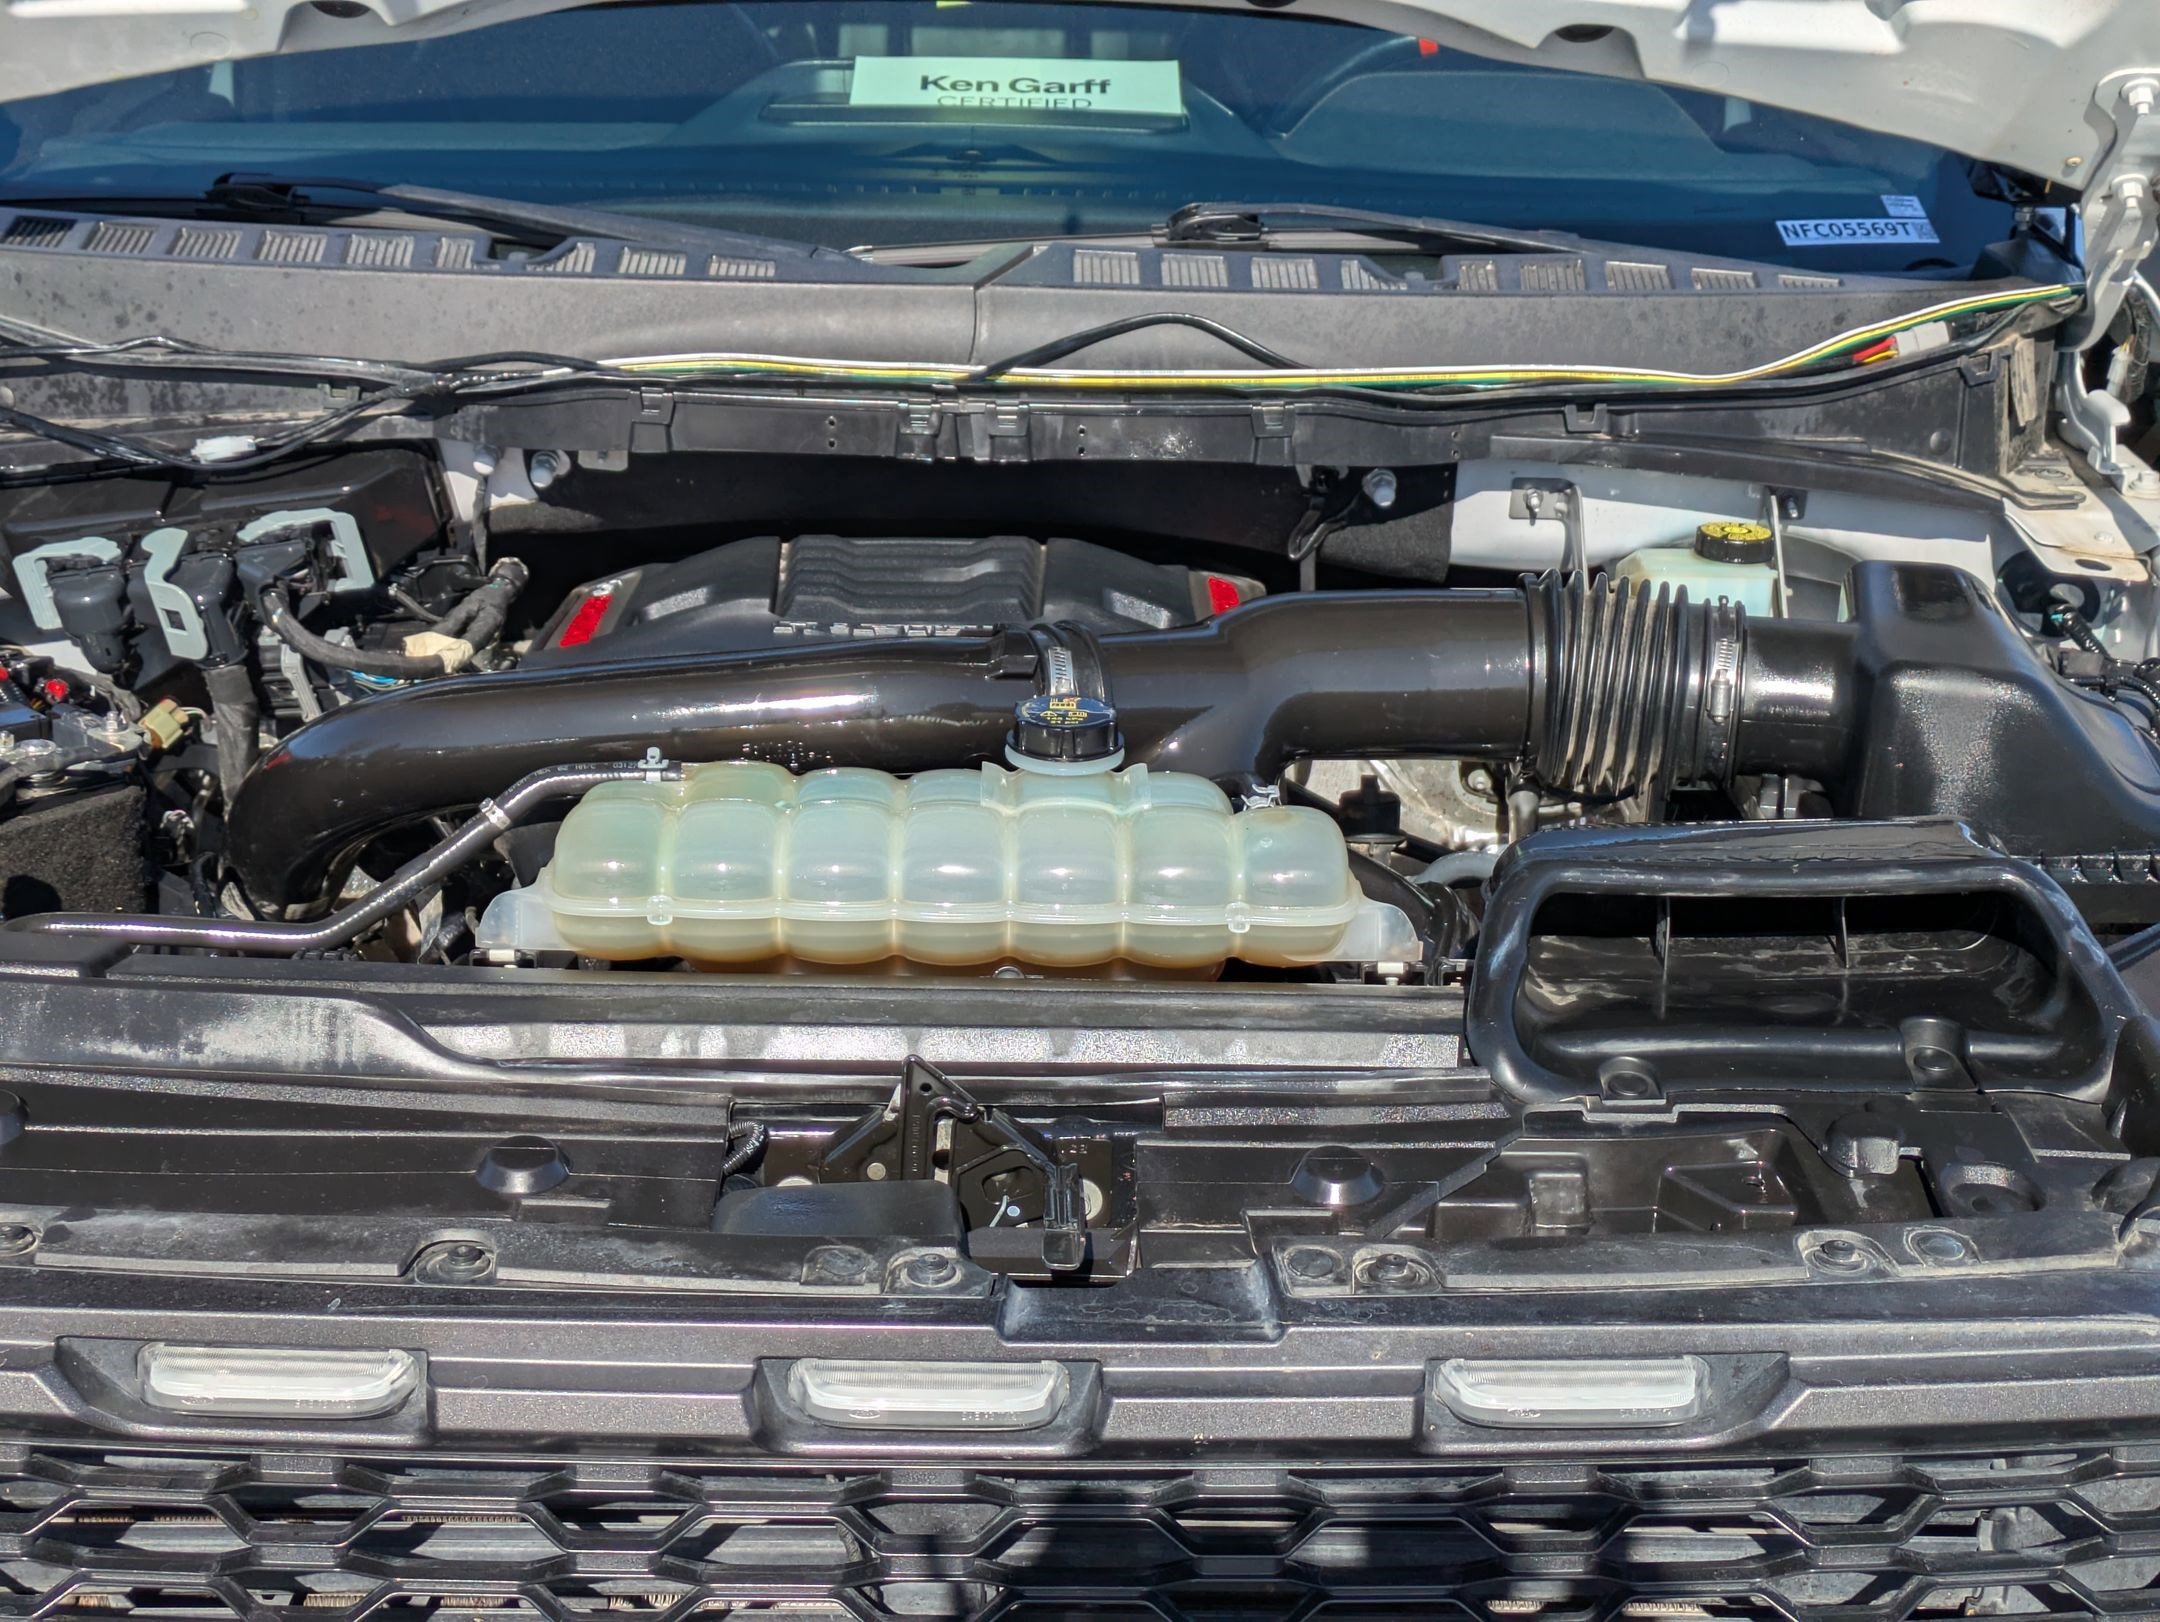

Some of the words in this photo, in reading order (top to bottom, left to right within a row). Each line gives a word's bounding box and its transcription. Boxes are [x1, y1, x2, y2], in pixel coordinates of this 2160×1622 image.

[920, 75, 999, 92] Ken
[1008, 77, 1111, 94] Garff
[1782, 222, 1911, 238] NFC05569T
